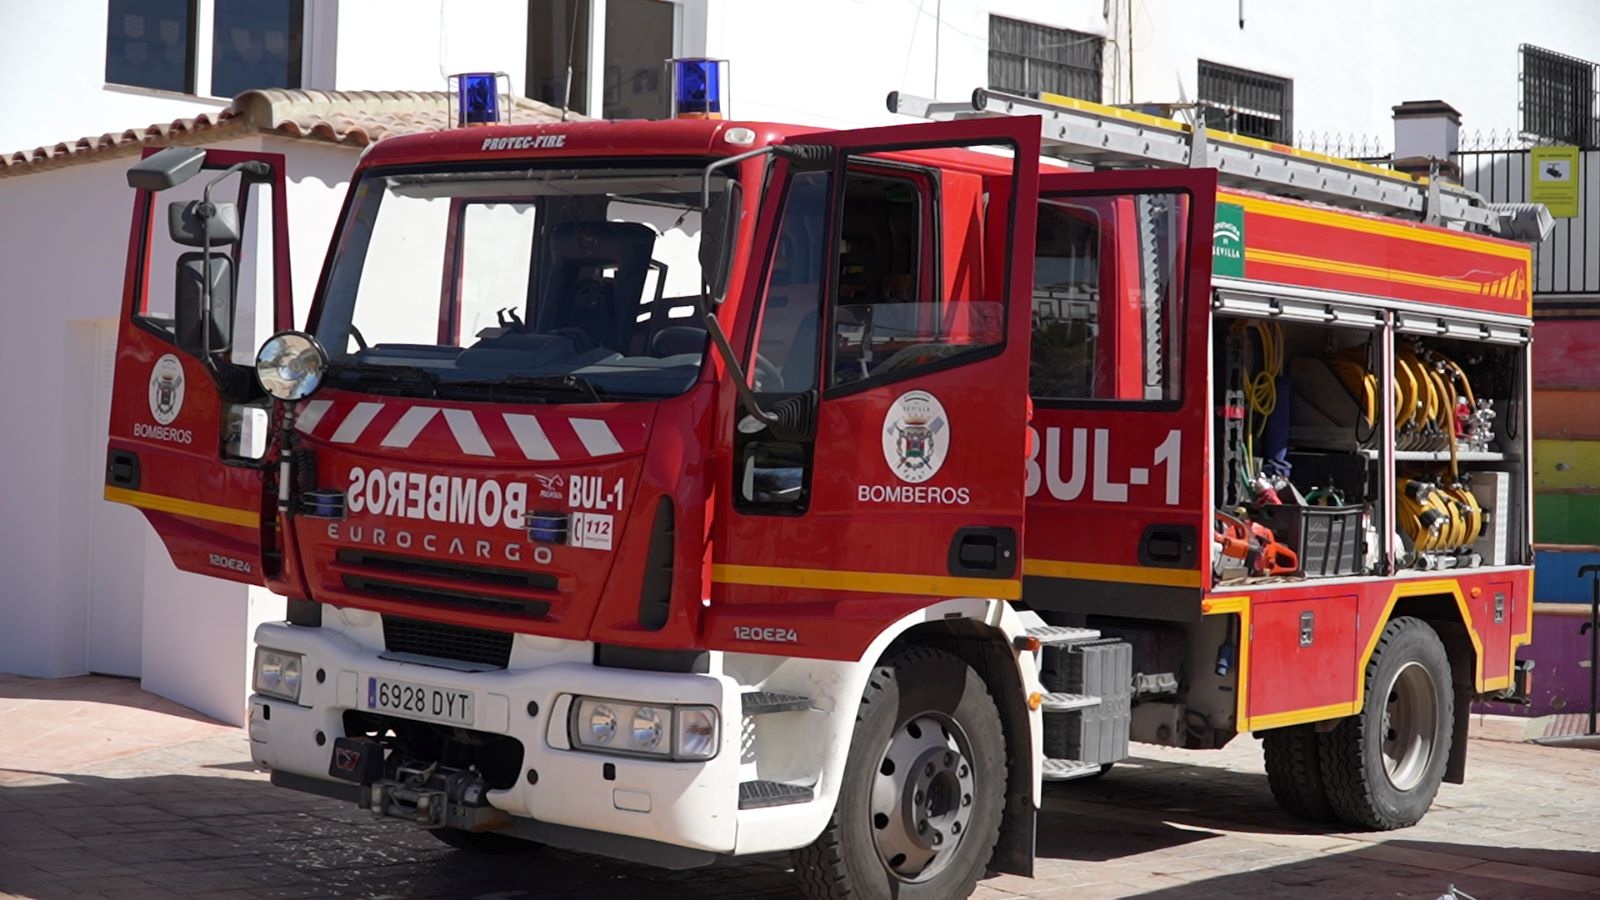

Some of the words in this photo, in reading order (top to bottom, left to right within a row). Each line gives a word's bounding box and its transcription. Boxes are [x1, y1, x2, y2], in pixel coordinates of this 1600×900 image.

[481, 135, 567, 151] PROTEC-FIRE
[133, 423, 192, 444] BOMBEROS
[568, 475, 624, 511] BUL-1
[857, 485, 971, 505] BOMBEROS
[586, 520, 611, 535] 112
[327, 522, 553, 565] EUROCARGO
[209, 553, 252, 573] 120E24
[733, 626, 798, 642] 120E24
[380, 682, 426, 712] 6928
[432, 690, 469, 719] DYT
